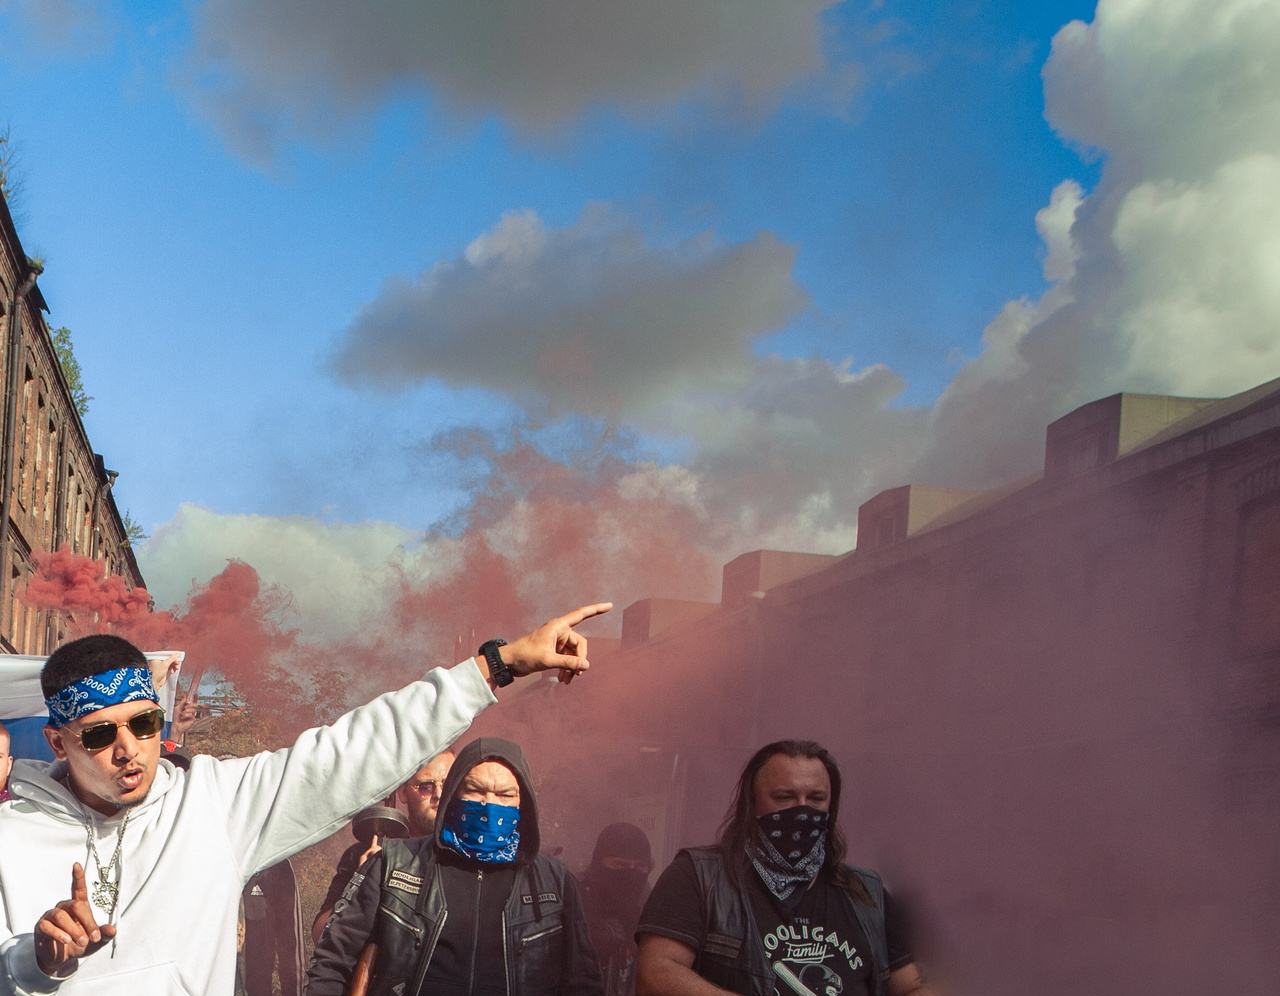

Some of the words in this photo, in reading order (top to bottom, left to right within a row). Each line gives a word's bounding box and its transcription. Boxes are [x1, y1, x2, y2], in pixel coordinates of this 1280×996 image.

[393, 871, 424, 883] HOOLIGAN
[524, 893, 556, 903] MBER
[794, 917, 810, 925] THE
[782, 942, 834, 963] Family
